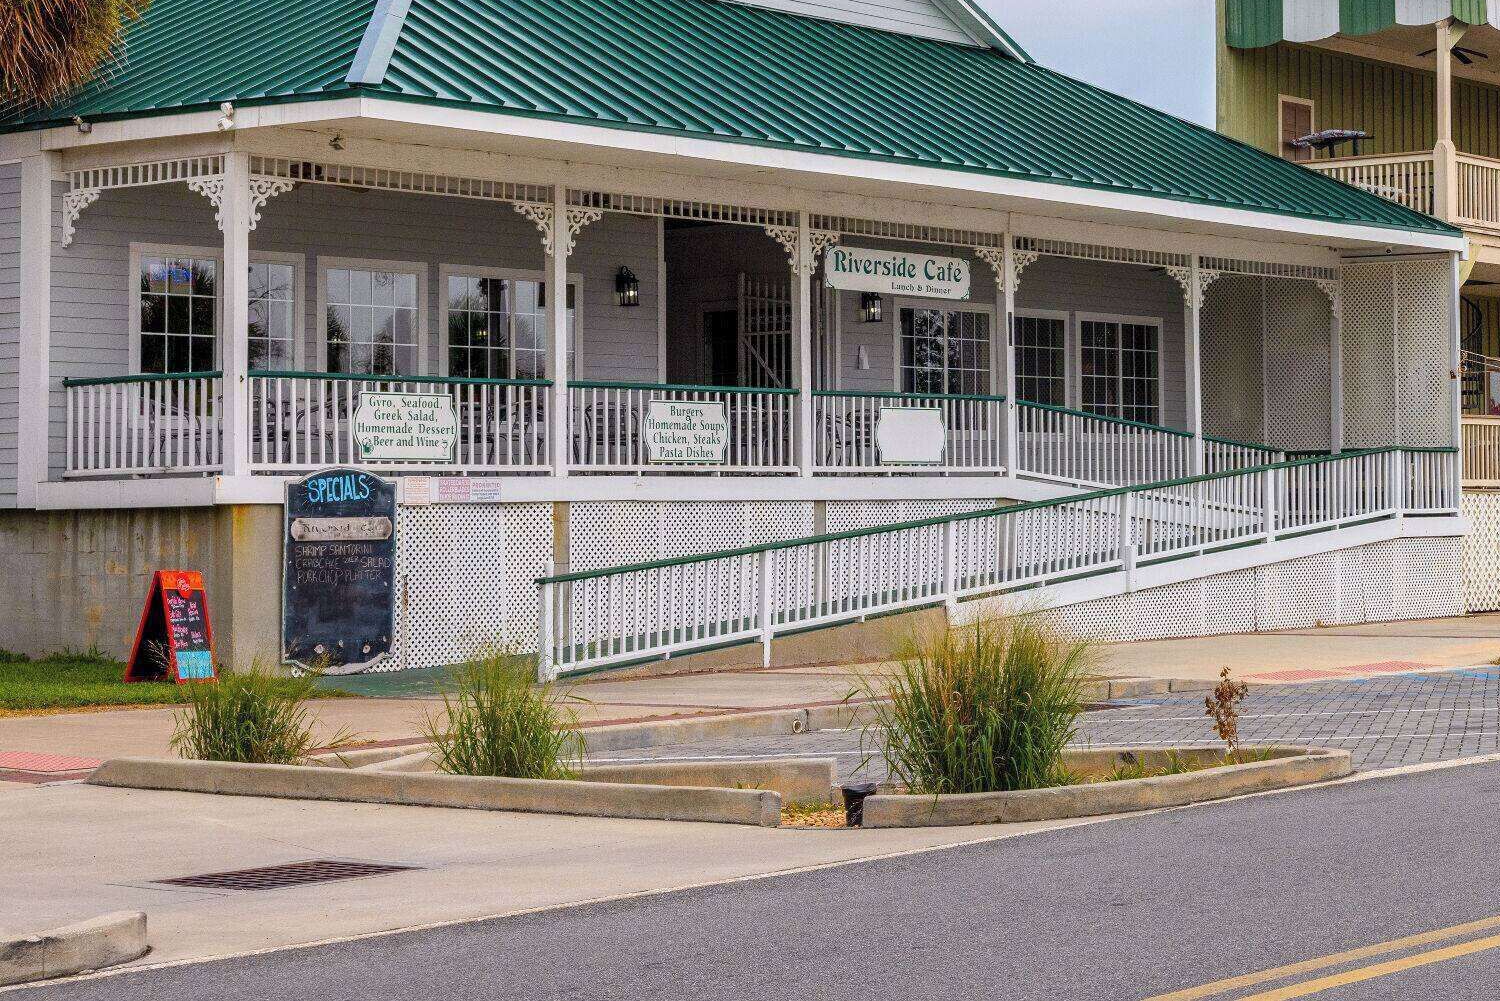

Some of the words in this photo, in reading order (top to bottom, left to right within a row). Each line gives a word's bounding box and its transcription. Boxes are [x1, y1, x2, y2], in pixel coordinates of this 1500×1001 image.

[833, 249, 917, 279] Riverside
[923, 259, 963, 283] Café
[891, 282, 915, 292] Lunch
[925, 285, 952, 295] Dinner
[401, 397, 443, 409] Seafood,
[374, 408, 402, 420] Greek
[407, 410, 438, 422] Salad,
[670, 405, 704, 421] Burgers
[357, 422, 413, 434] Homemade
[418, 424, 455, 435] Dessert
[648, 419, 697, 431] Homemade
[700, 420, 725, 435] Soups
[373, 435, 393, 446] Beer
[396, 436, 414, 447] and
[416, 436, 439, 447] Wine
[653, 432, 690, 445] Chicken,
[693, 433, 721, 445] Steaks
[659, 447, 683, 458] Pasta
[686, 446, 714, 458] Dishes
[306, 474, 370, 503] SPECIALS
[295, 545, 327, 557] SHRIMP
[360, 556, 392, 568] SALAD
